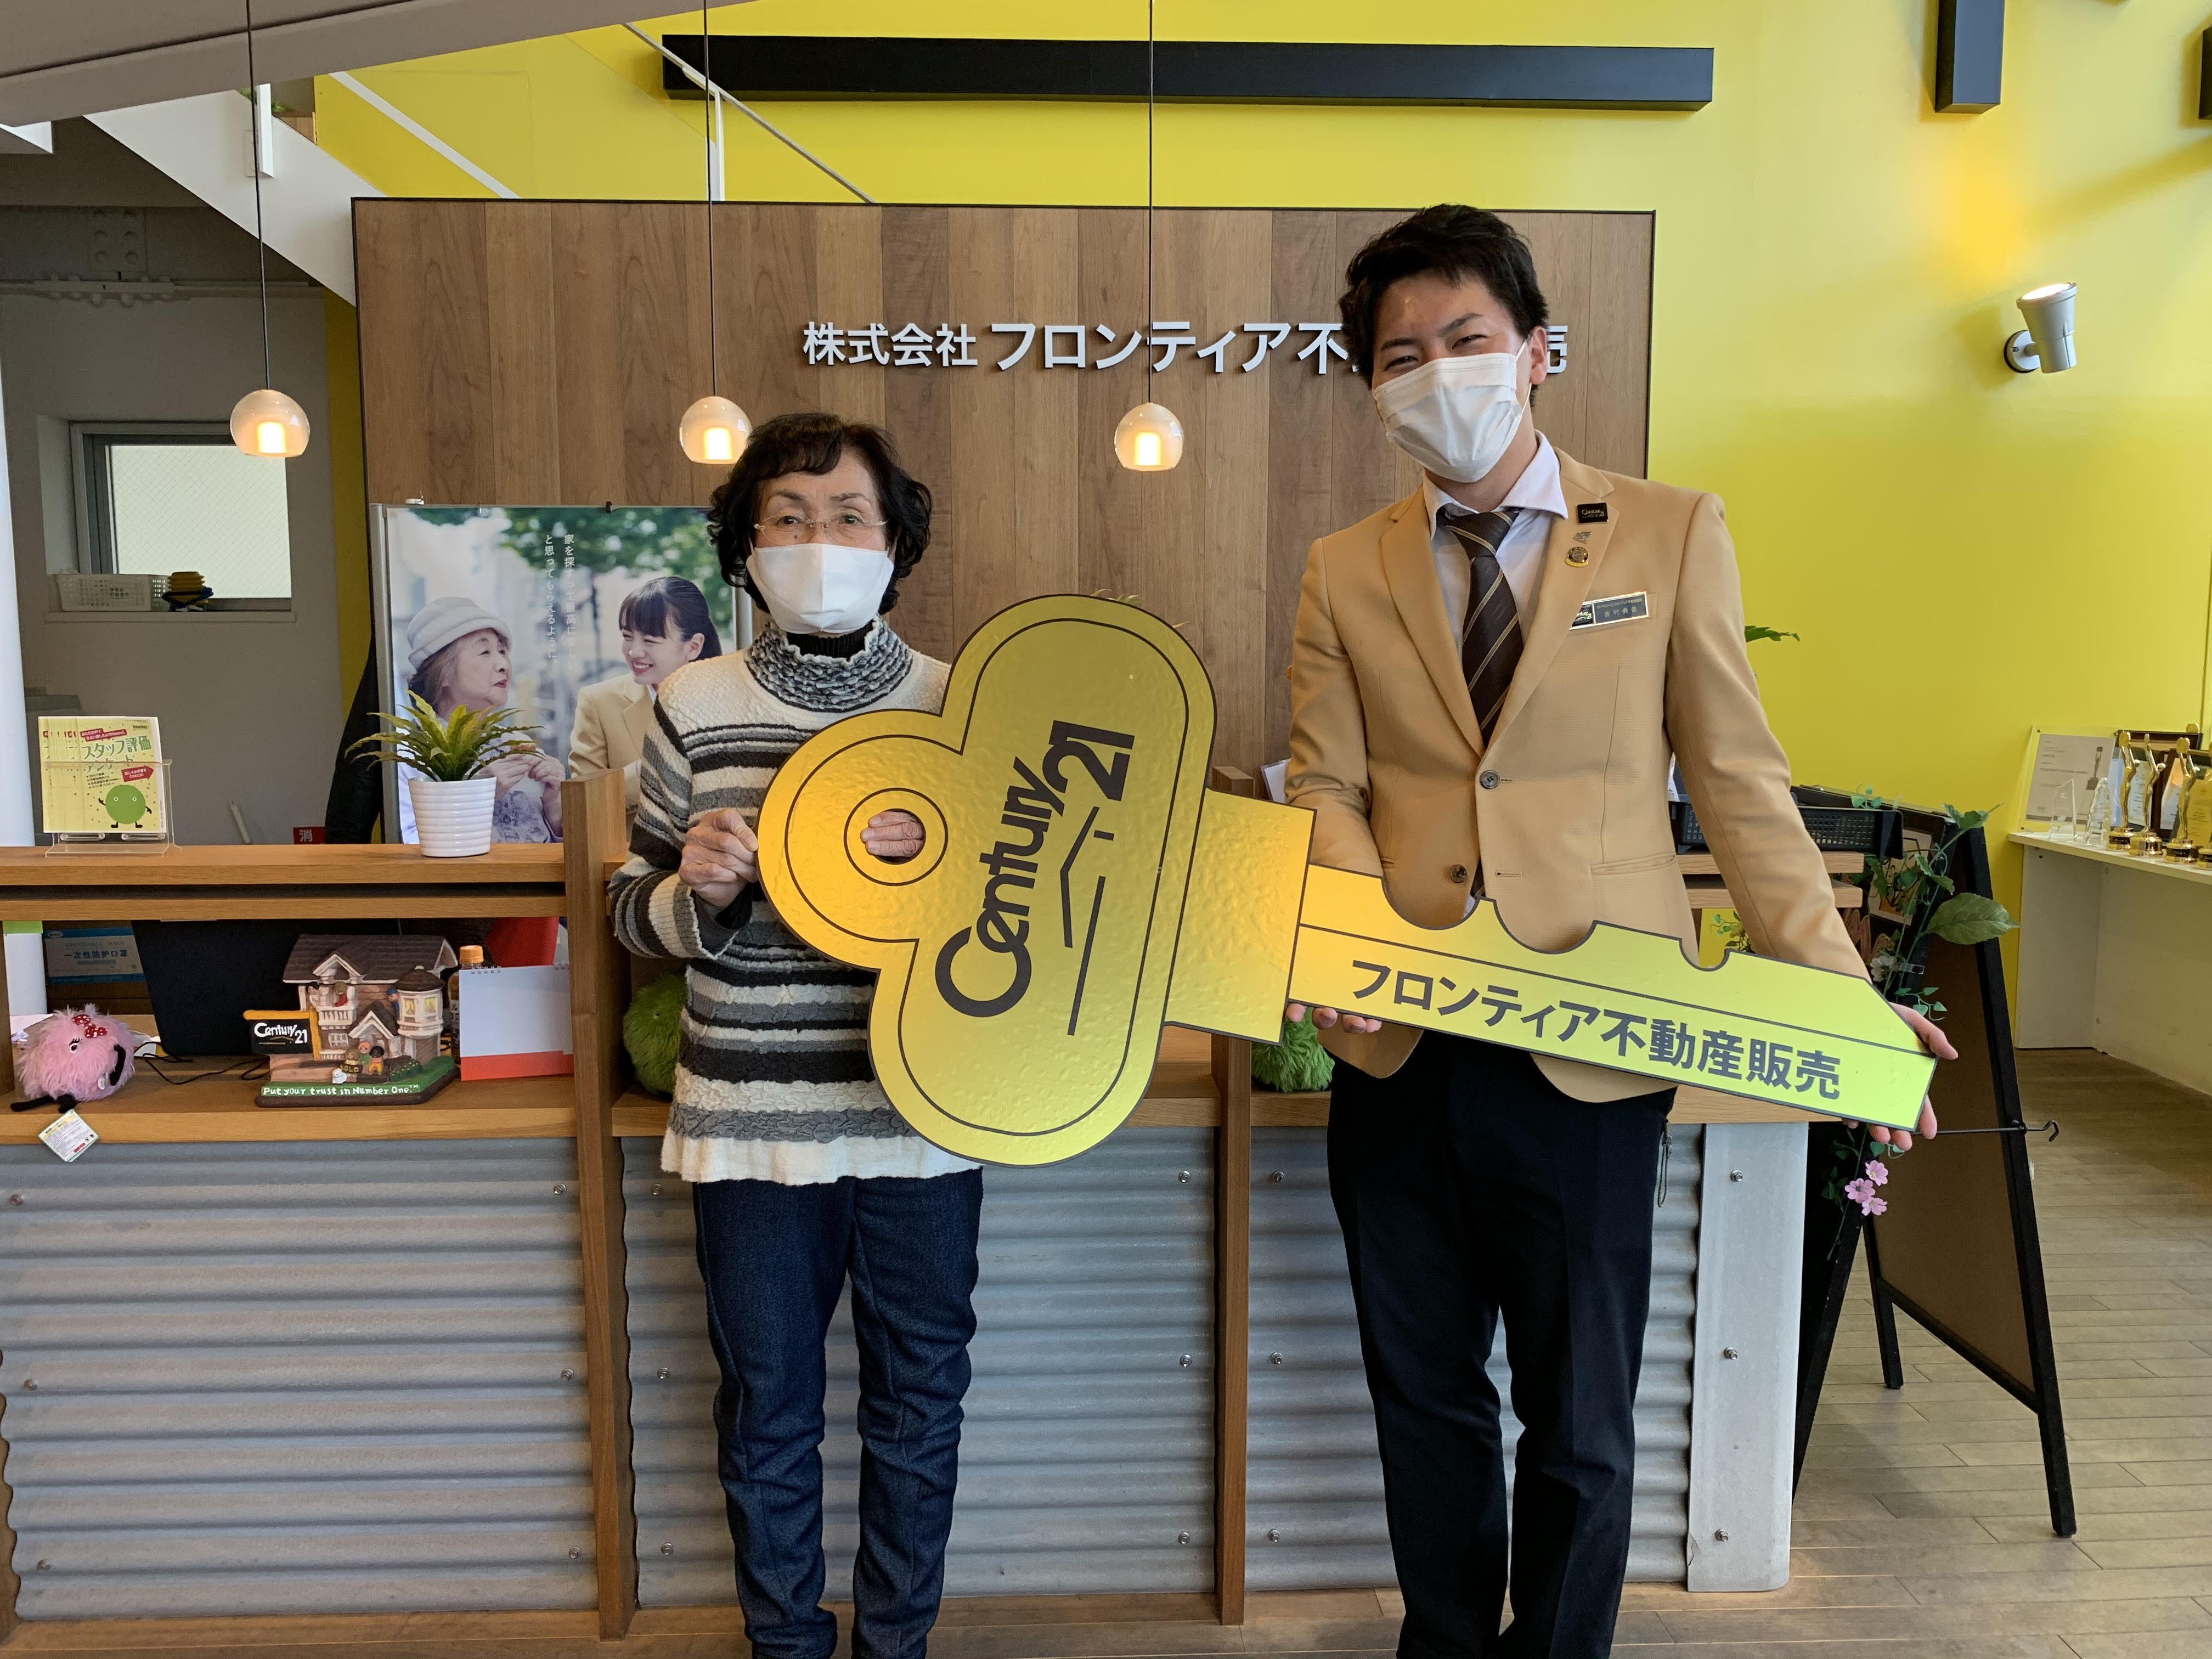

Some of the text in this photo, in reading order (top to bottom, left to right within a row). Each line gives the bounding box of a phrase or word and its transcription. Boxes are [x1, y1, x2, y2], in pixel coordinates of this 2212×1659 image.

[803, 321, 978, 366] 株式会社
[544, 534, 558, 665] と思ってもらえるように。
[81, 735, 152, 760] スタッフ評価
[85, 755, 133, 773] アンケート
[299, 829, 313, 842] 消
[64, 949, 127, 960] 一次性防护口罩
[1352, 959, 1841, 1100] フロンティア不動産販売
[263, 1087, 281, 1096] Put
[284, 1087, 306, 1096] your
[311, 1086, 337, 1096] trust
[340, 1086, 351, 1095] in
[353, 1086, 389, 1095] Number
